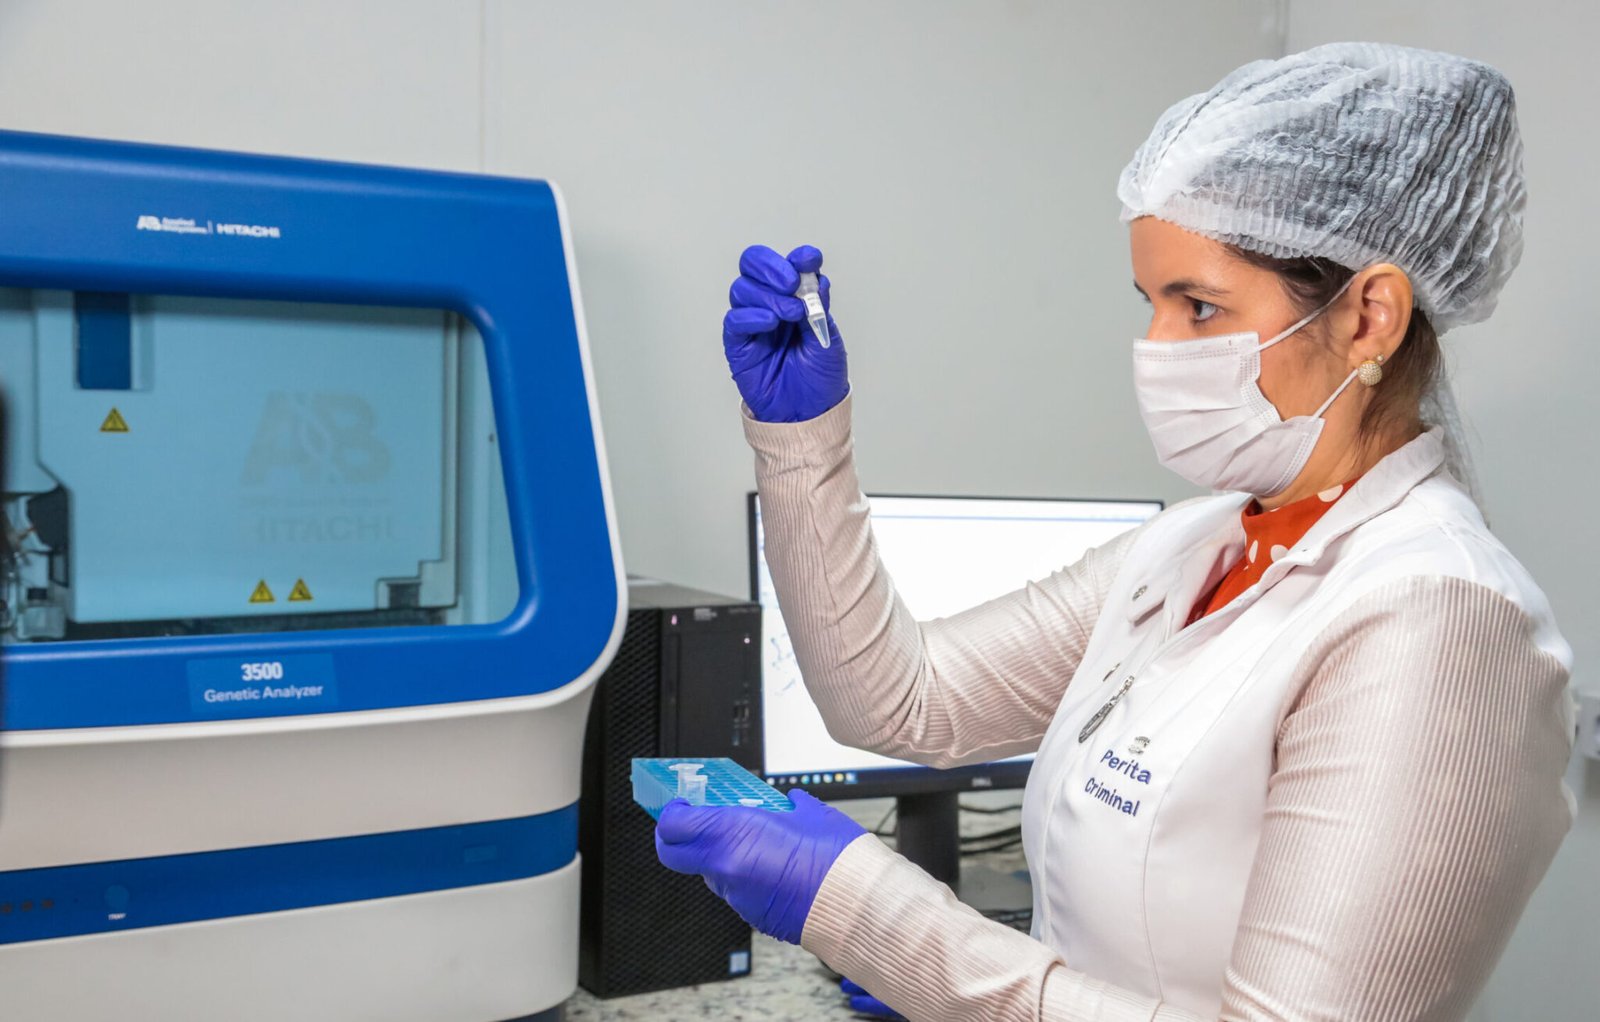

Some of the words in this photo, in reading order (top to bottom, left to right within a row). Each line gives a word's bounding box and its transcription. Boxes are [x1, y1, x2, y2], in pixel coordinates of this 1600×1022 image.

[217, 223, 280, 238] HITACHI
[241, 662, 283, 681] 3500
[204, 689, 260, 702] Genetic
[262, 685, 323, 699] Analyzer
[1100, 749, 1152, 785] Perita
[1084, 777, 1140, 817] Criminal
